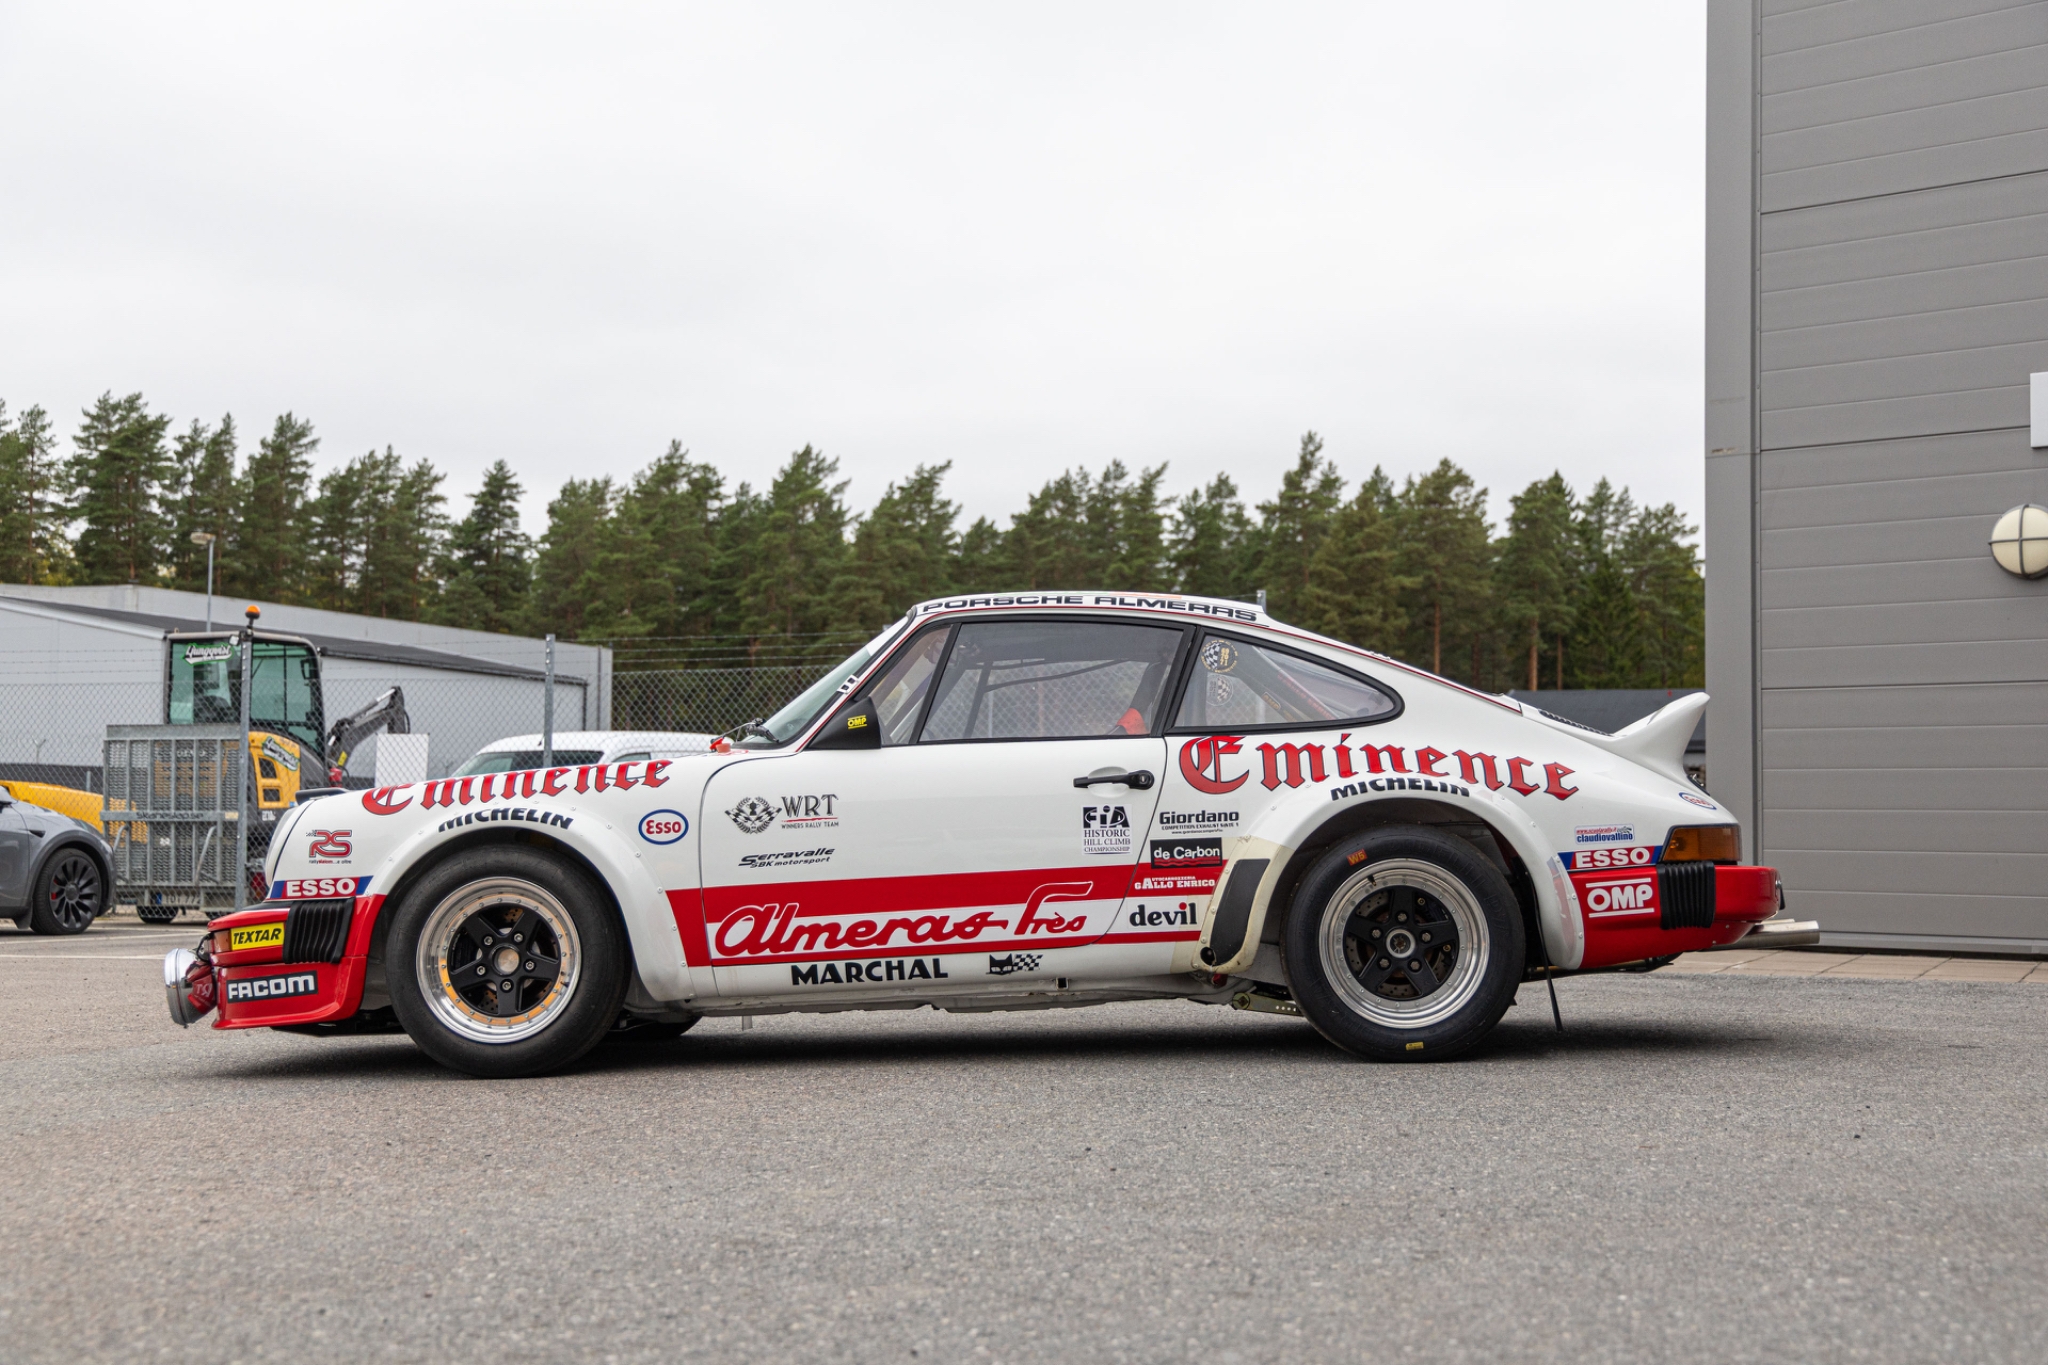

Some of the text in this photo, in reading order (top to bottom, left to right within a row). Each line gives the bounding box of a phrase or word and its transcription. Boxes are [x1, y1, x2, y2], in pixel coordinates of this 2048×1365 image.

[923, 594, 1258, 622] PORSCHE ALMERAS
[847, 716, 867, 728] OMP
[1179, 733, 1579, 801] Eminence
[362, 759, 673, 816] Eminence
[1330, 777, 1470, 802] MICHELIN
[781, 794, 839, 818] WRT
[438, 807, 574, 832] MICHELIN
[645, 818, 682, 835] Esso
[781, 820, 840, 830] WINNERS RALLY TEAM
[1159, 810, 1239, 824] Giordano
[1083, 829, 1131, 838] HISTORIC
[1083, 837, 1131, 846] HILL CLIMB
[1577, 832, 1634, 844] claudiovallino
[738, 846, 836, 867] Serravalle
[1083, 845, 1131, 853] CHAMPIONSHIP
[1153, 845, 1220, 860] de Carbon
[1575, 847, 1651, 868] ESSO
[750, 856, 831, 869] SBK motorsport
[286, 877, 356, 897] ESSO
[1177, 879, 1215, 889] ENRICO
[1587, 884, 1653, 911] OMP
[1129, 902, 1197, 927] devil
[232, 926, 283, 946] TEXTAR
[791, 957, 949, 986] MARCHAL
[227, 974, 316, 1002] FACOM
